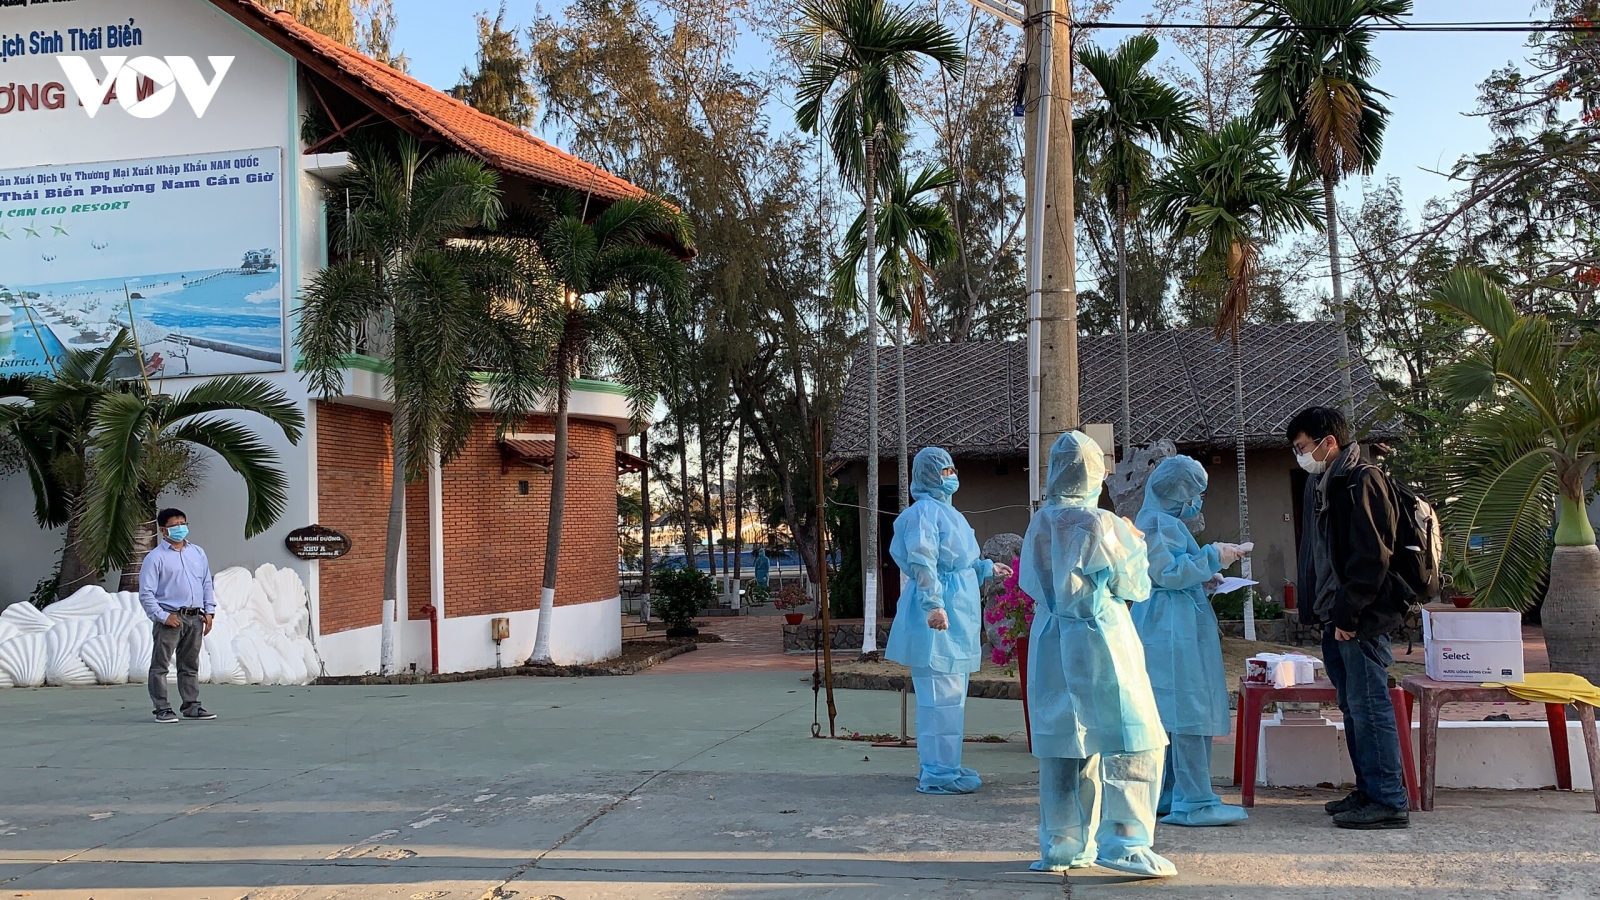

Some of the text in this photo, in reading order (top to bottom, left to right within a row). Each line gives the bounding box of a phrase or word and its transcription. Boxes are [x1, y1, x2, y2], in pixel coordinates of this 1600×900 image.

[29, 30, 63, 55] Sinh
[67, 26, 102, 51] Thái
[106, 17, 142, 48] Biển
[13, 174, 35, 186] Xuất
[37, 173, 57, 186] Dịch
[60, 172, 72, 184] Vụ
[75, 171, 110, 181] Thương
[112, 168, 130, 180] Mại
[132, 164, 153, 176] Xuất
[156, 164, 180, 176] Nhập
[183, 160, 207, 173] Khẩu
[210, 160, 231, 171] NAM
[234, 154, 259, 170] QUỐC
[0, 171, 275, 202] Thái Biển Phương Nam Cần Giờ
[7, 207, 37, 218] CAN
[41, 206, 67, 216] GIO
[71, 201, 130, 213] RESORT
